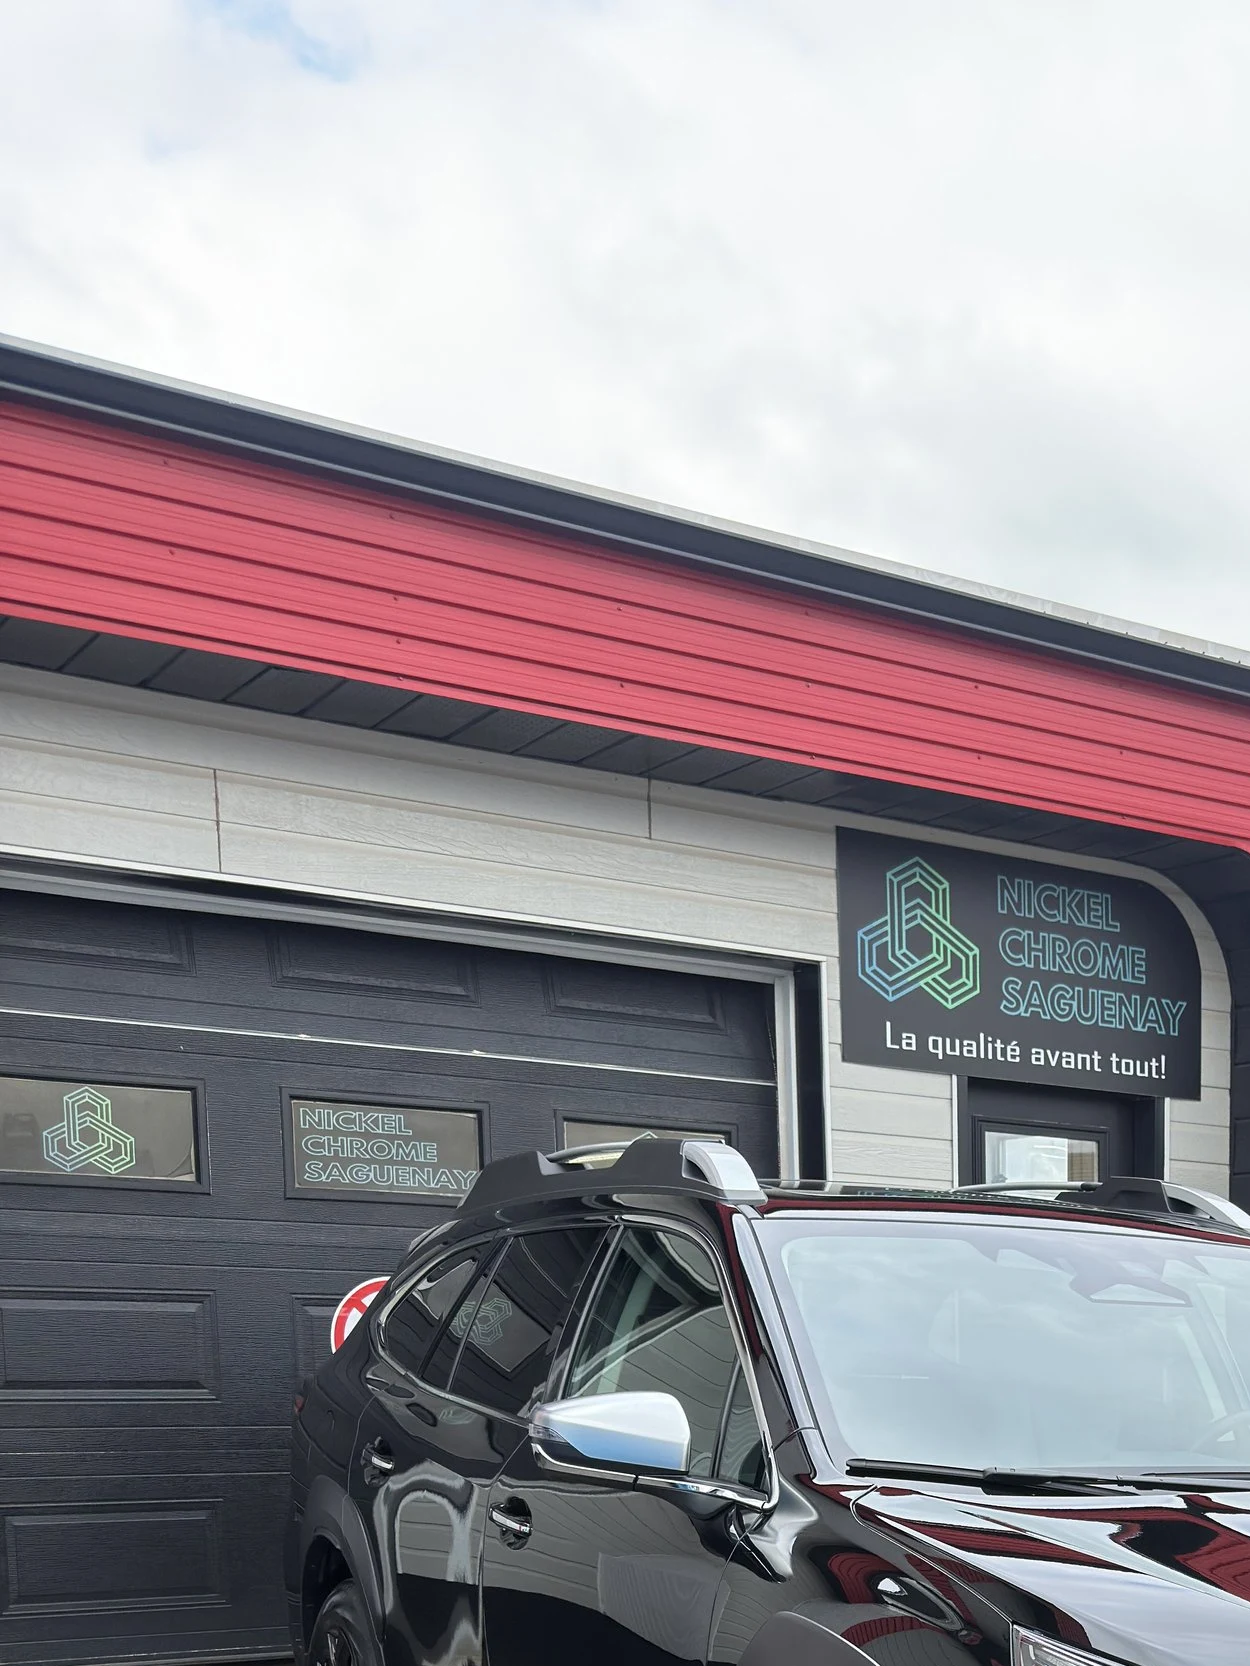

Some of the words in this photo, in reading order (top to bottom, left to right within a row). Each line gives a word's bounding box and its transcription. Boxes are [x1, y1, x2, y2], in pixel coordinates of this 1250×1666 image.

[997, 875, 1120, 932] NICKEL
[999, 928, 1146, 984] CHROME
[1000, 977, 1187, 1036] SAGUENAY
[885, 1021, 917, 1050] La
[928, 1033, 1021, 1063] qualité
[1031, 1048, 1102, 1074] avant
[1110, 1053, 1167, 1079] tout!
[300, 1107, 412, 1135] NICKEL
[302, 1134, 437, 1162] CHROME
[304, 1160, 477, 1189] SAGUENAY
